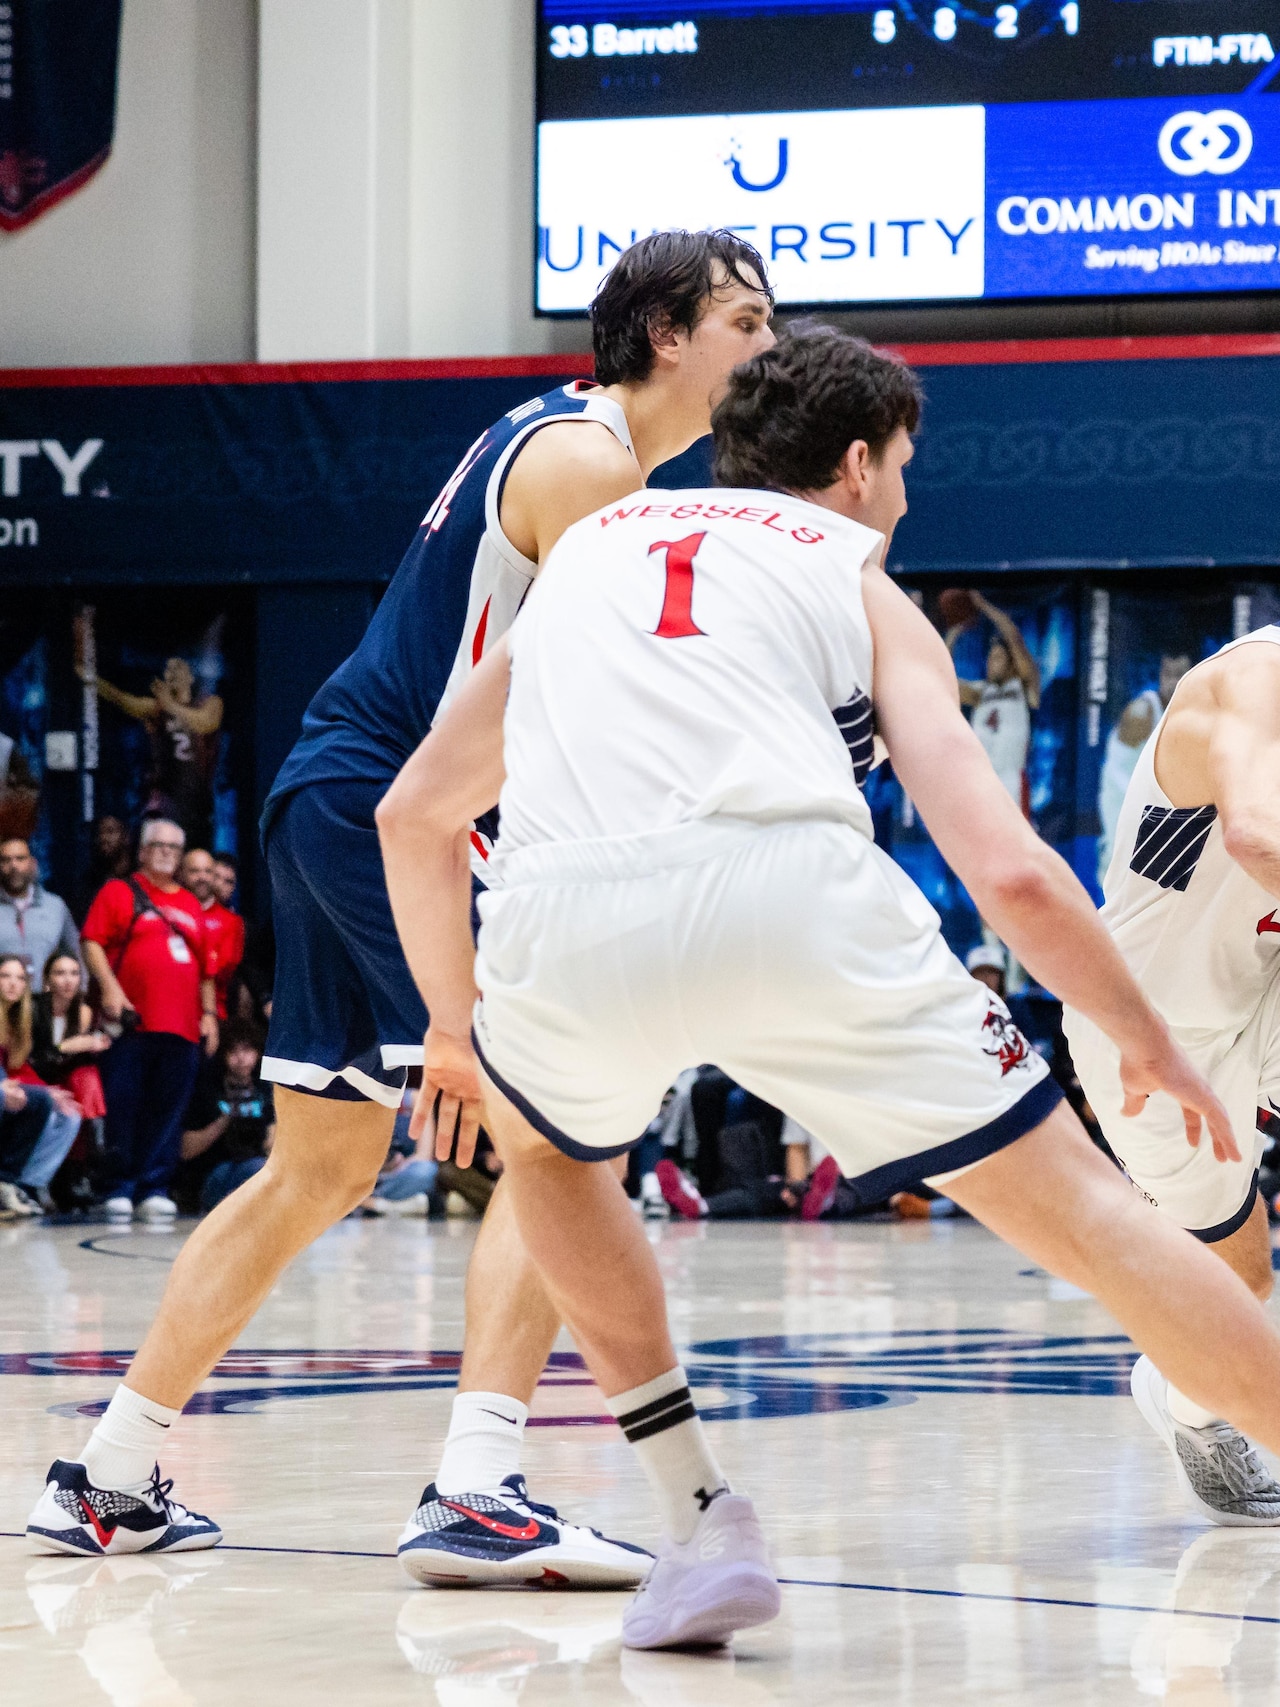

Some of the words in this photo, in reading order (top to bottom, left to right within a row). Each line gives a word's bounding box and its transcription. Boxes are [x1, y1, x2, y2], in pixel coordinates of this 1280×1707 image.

[549, 24, 588, 58] 33
[592, 21, 698, 56] Barrett
[872, 11, 896, 43] 5
[933, 8, 957, 40] 8
[993, 5, 1018, 38] 2
[1060, 2, 1079, 35] 1
[999, 194, 1195, 235] COMMON
[1084, 244, 1160, 272] Serving
[1222, 239, 1277, 264] Since
[600, 503, 825, 544] WESSELS
[643, 530, 711, 639] 1
